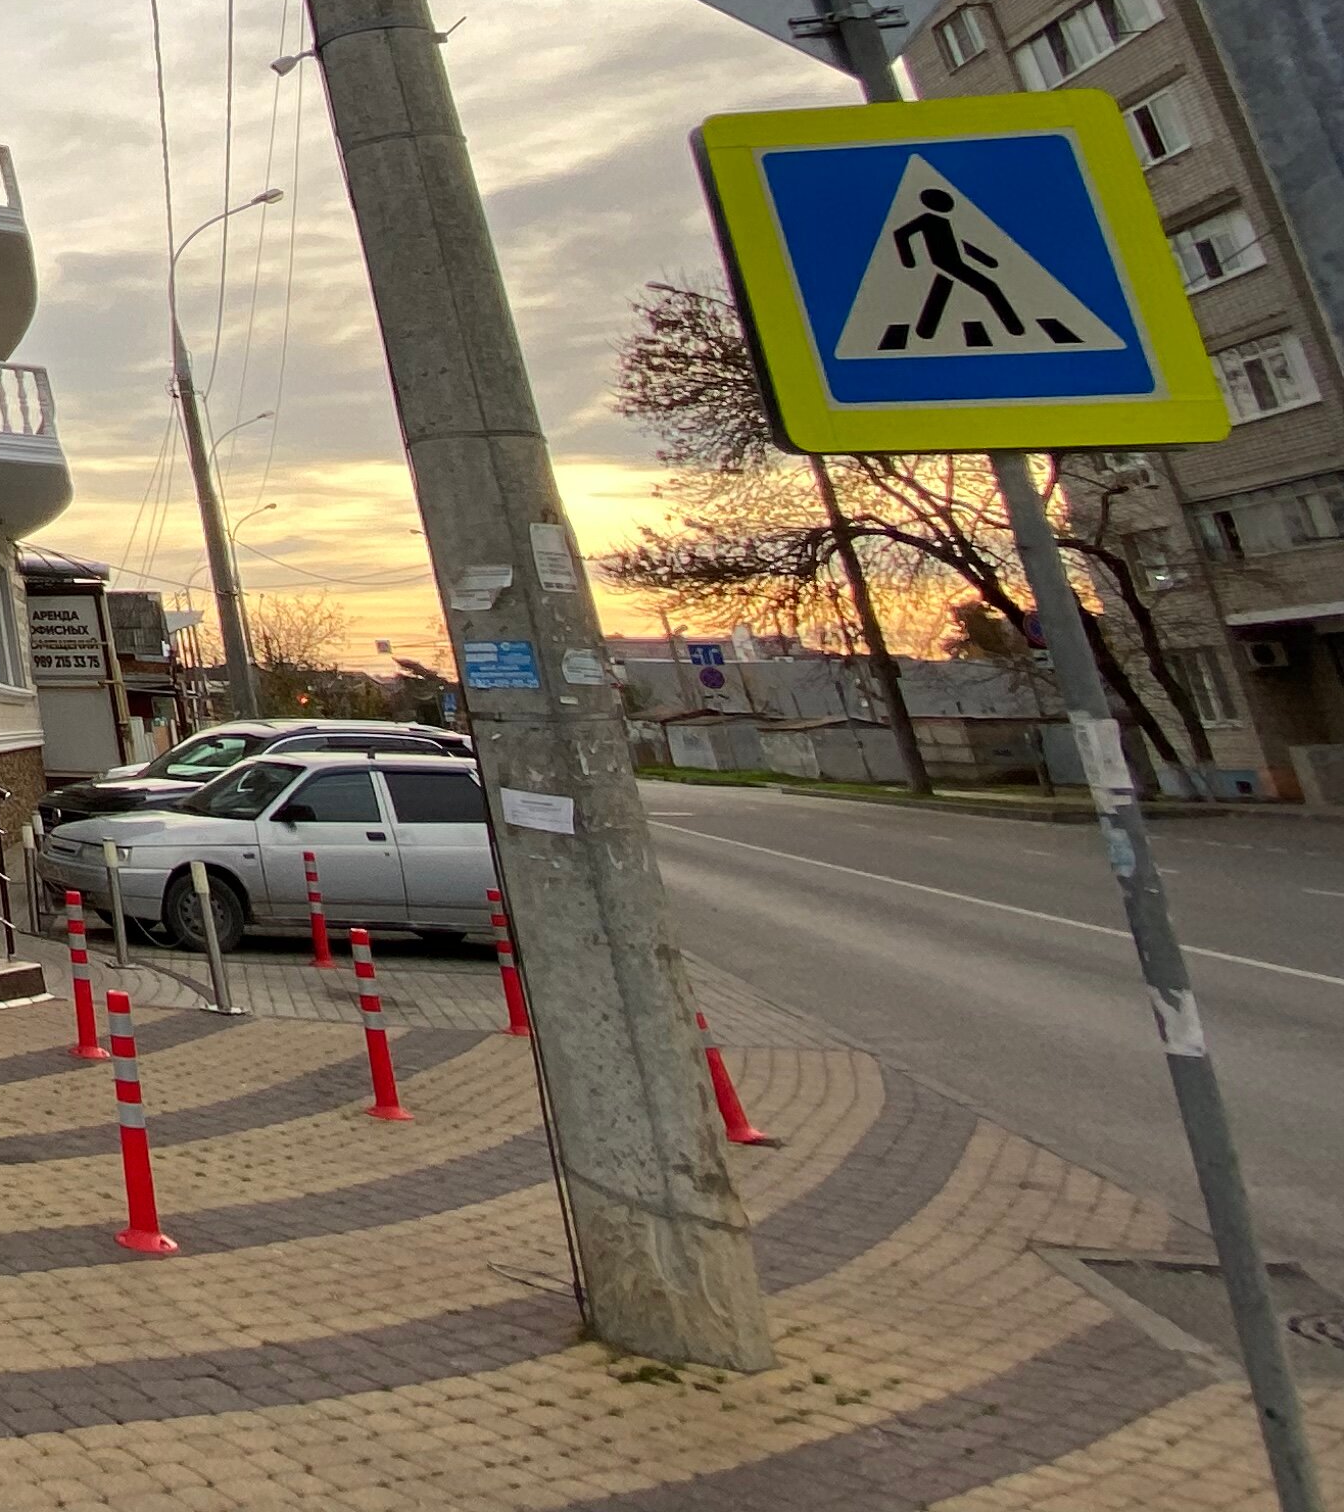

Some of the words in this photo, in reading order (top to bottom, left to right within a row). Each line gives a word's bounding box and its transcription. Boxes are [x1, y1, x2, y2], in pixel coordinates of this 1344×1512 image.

[32, 610, 79, 622] АРЕНДА
[34, 655, 53, 668] 989
[55, 655, 72, 668] 215
[73, 655, 87, 668] 33
[87, 655, 100, 669] 75
